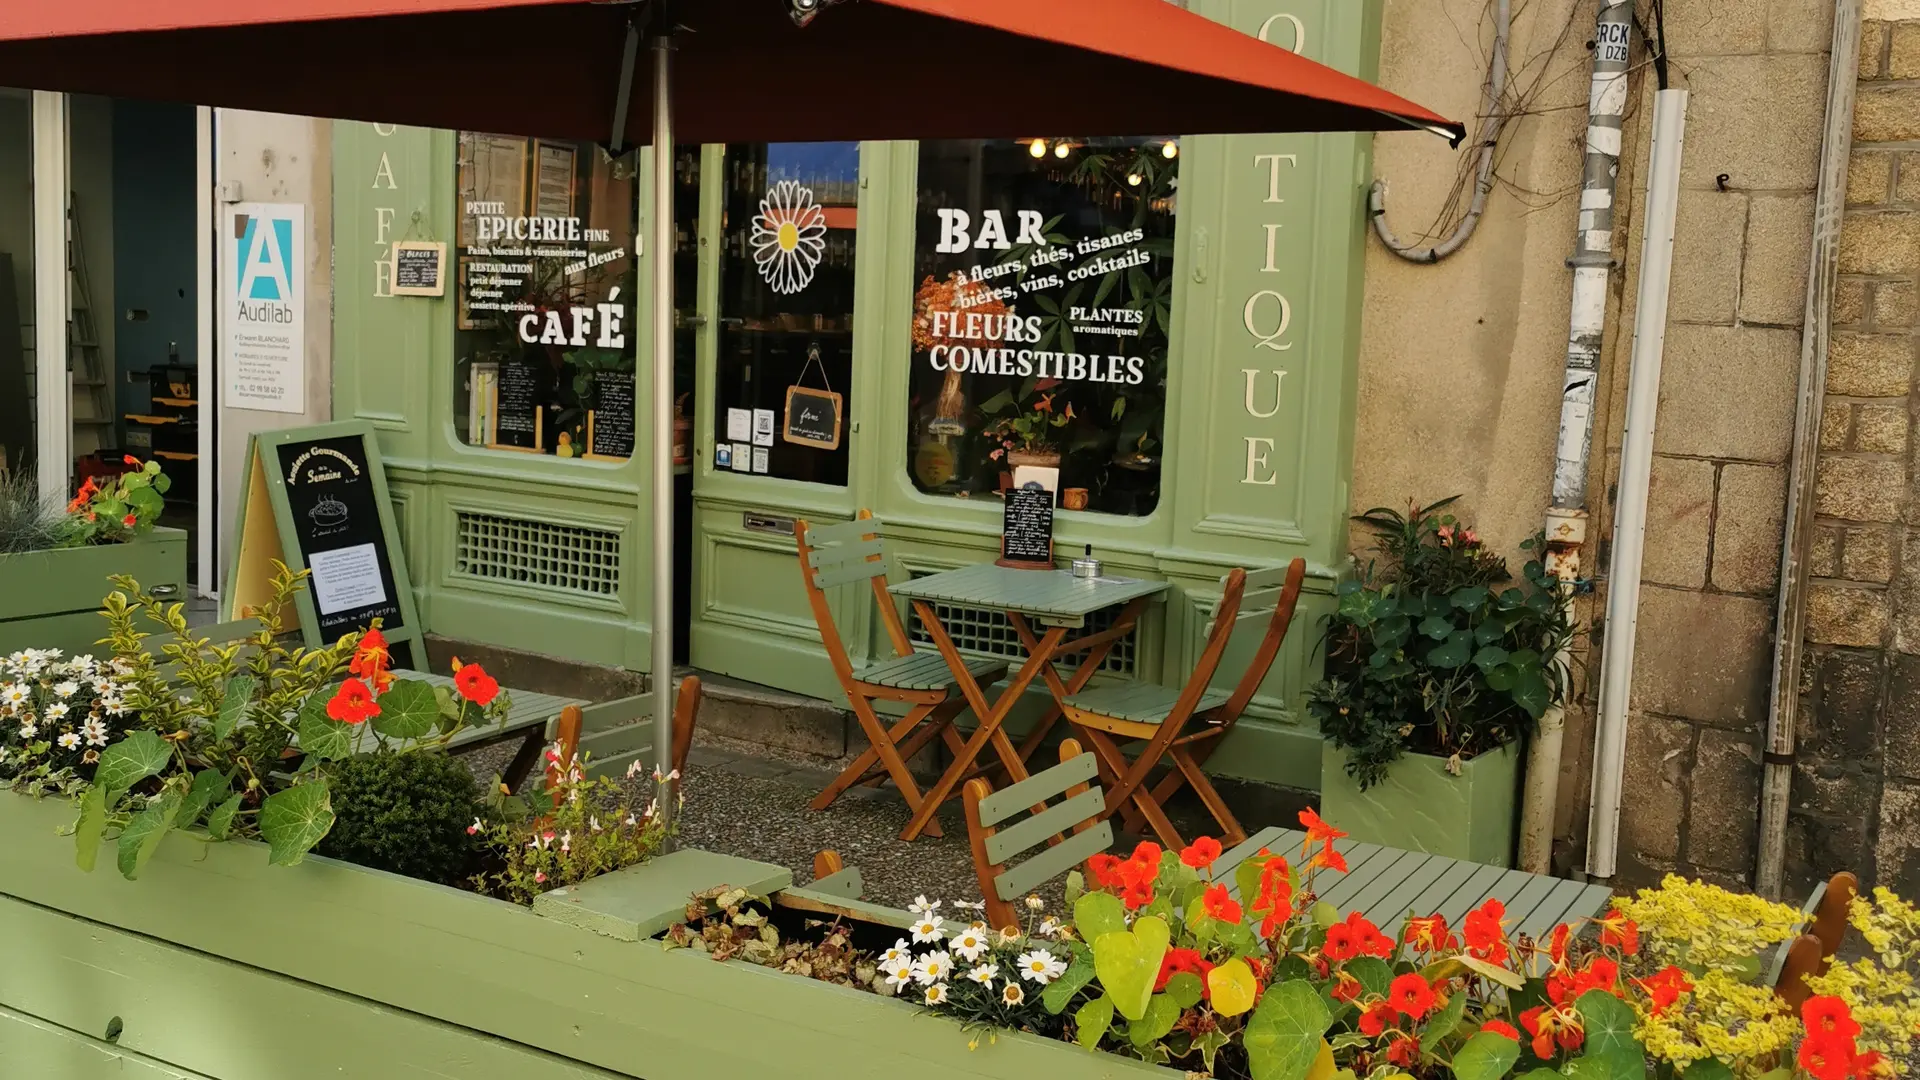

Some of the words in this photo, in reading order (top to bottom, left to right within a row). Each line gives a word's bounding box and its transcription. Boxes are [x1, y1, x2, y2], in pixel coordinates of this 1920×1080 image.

[1597, 24, 1629, 44] RCK
[1606, 46, 1627, 60] DZB
[466, 202, 504, 214] PETITE
[478, 216, 580, 241] EPICERIE
[584, 229, 610, 242] FINE
[936, 208, 1046, 254] BAR
[467, 246, 492, 257] Pains,
[492, 246, 524, 256] biscuits
[525, 247, 532, 256] &
[533, 247, 587, 258] viennoiseries
[957, 270, 968, 286] à
[971, 258, 1028, 284] fleurs,
[1030, 246, 1074, 268] thés,
[1076, 228, 1144, 255] tisanes
[470, 263, 533, 274] RESTAURATION
[564, 261, 587, 276] aux
[588, 248, 625, 268] fleurs
[470, 276, 488, 286] petit
[489, 276, 522, 288] déjeuner
[958, 284, 1018, 310] bières,
[1020, 273, 1064, 294] vins,
[1067, 249, 1150, 282] cocktails
[470, 288, 504, 300] déjeuner
[470, 302, 500, 310] assiette
[501, 302, 536, 313] apéritive
[519, 286, 624, 348] CAFÉ
[1070, 306, 1144, 324] PLANTES
[932, 310, 1042, 344] FLEURS
[1073, 325, 1138, 338] aromatiques
[930, 345, 1144, 386] COMESTIBLES
[288, 452, 310, 486] Assiette
[311, 446, 360, 476] Gourmande
[307, 469, 342, 484] Semaine
